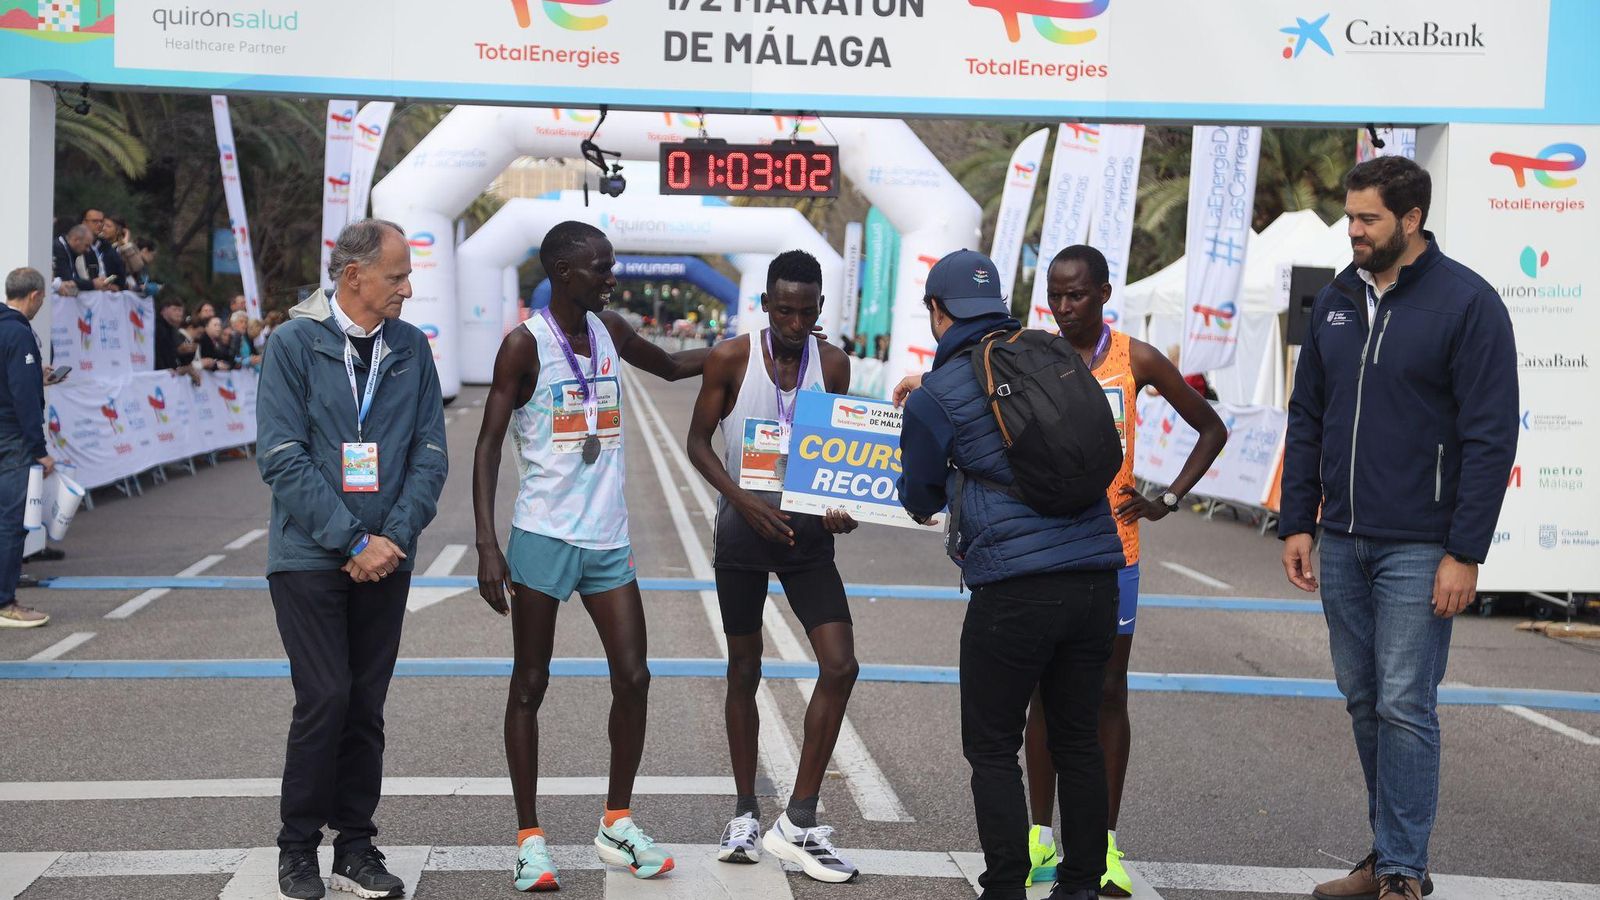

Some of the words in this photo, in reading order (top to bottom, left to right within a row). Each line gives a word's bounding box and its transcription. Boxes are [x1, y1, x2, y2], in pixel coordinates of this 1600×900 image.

[152, 7, 299, 31] quirónsalud
[1345, 19, 1485, 48] CaixaBank
[165, 37, 236, 54] Healthcare
[238, 42, 288, 55] Partner
[475, 42, 620, 68] TotalEnergies
[664, 30, 713, 63] DE
[724, 25, 892, 68] MÁLAGA
[965, 57, 1109, 82] TotalEnergies
[667, 151, 832, 192] 01:03:02
[1207, 126, 1230, 230] LaEnergíaD
[1224, 126, 1250, 231] LasCarrera
[1488, 198, 1585, 213] TotalEnergies
[626, 262, 687, 275] HYUNDAI
[1496, 284, 1582, 298] uirónsalud
[869, 418, 880, 426] DE
[880, 418, 903, 429] MÁLA
[871, 408, 882, 417] 1/2
[882, 411, 904, 420] MARA
[799, 434, 903, 473] COURS
[1539, 466, 1583, 475] metro
[811, 467, 899, 501] RECO
[1539, 477, 1583, 491] Málaga
[1561, 529, 1589, 537] Ciudad
